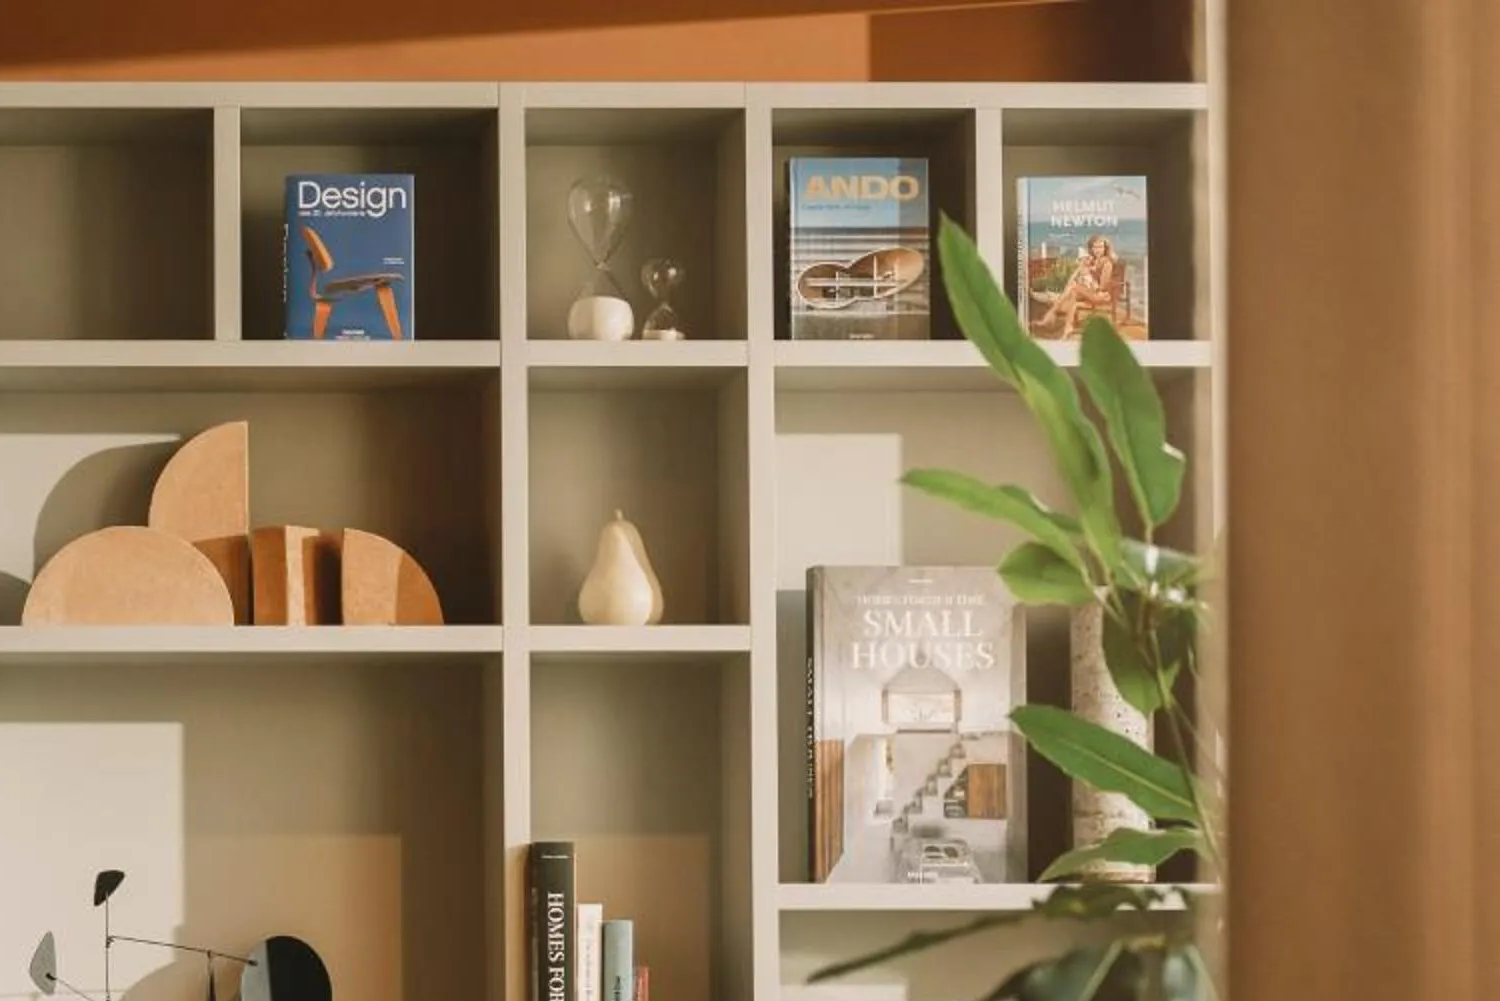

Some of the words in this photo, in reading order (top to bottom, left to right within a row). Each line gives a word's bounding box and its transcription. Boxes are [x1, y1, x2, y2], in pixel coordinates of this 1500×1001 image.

[298, 181, 407, 218] Design
[805, 174, 921, 201] ANDO
[1049, 214, 1119, 228] NEWTON
[1051, 200, 1116, 214] HELMUT
[863, 609, 985, 638] SMALL
[852, 641, 996, 670] HOUSES
[547, 892, 565, 962] HOMES
